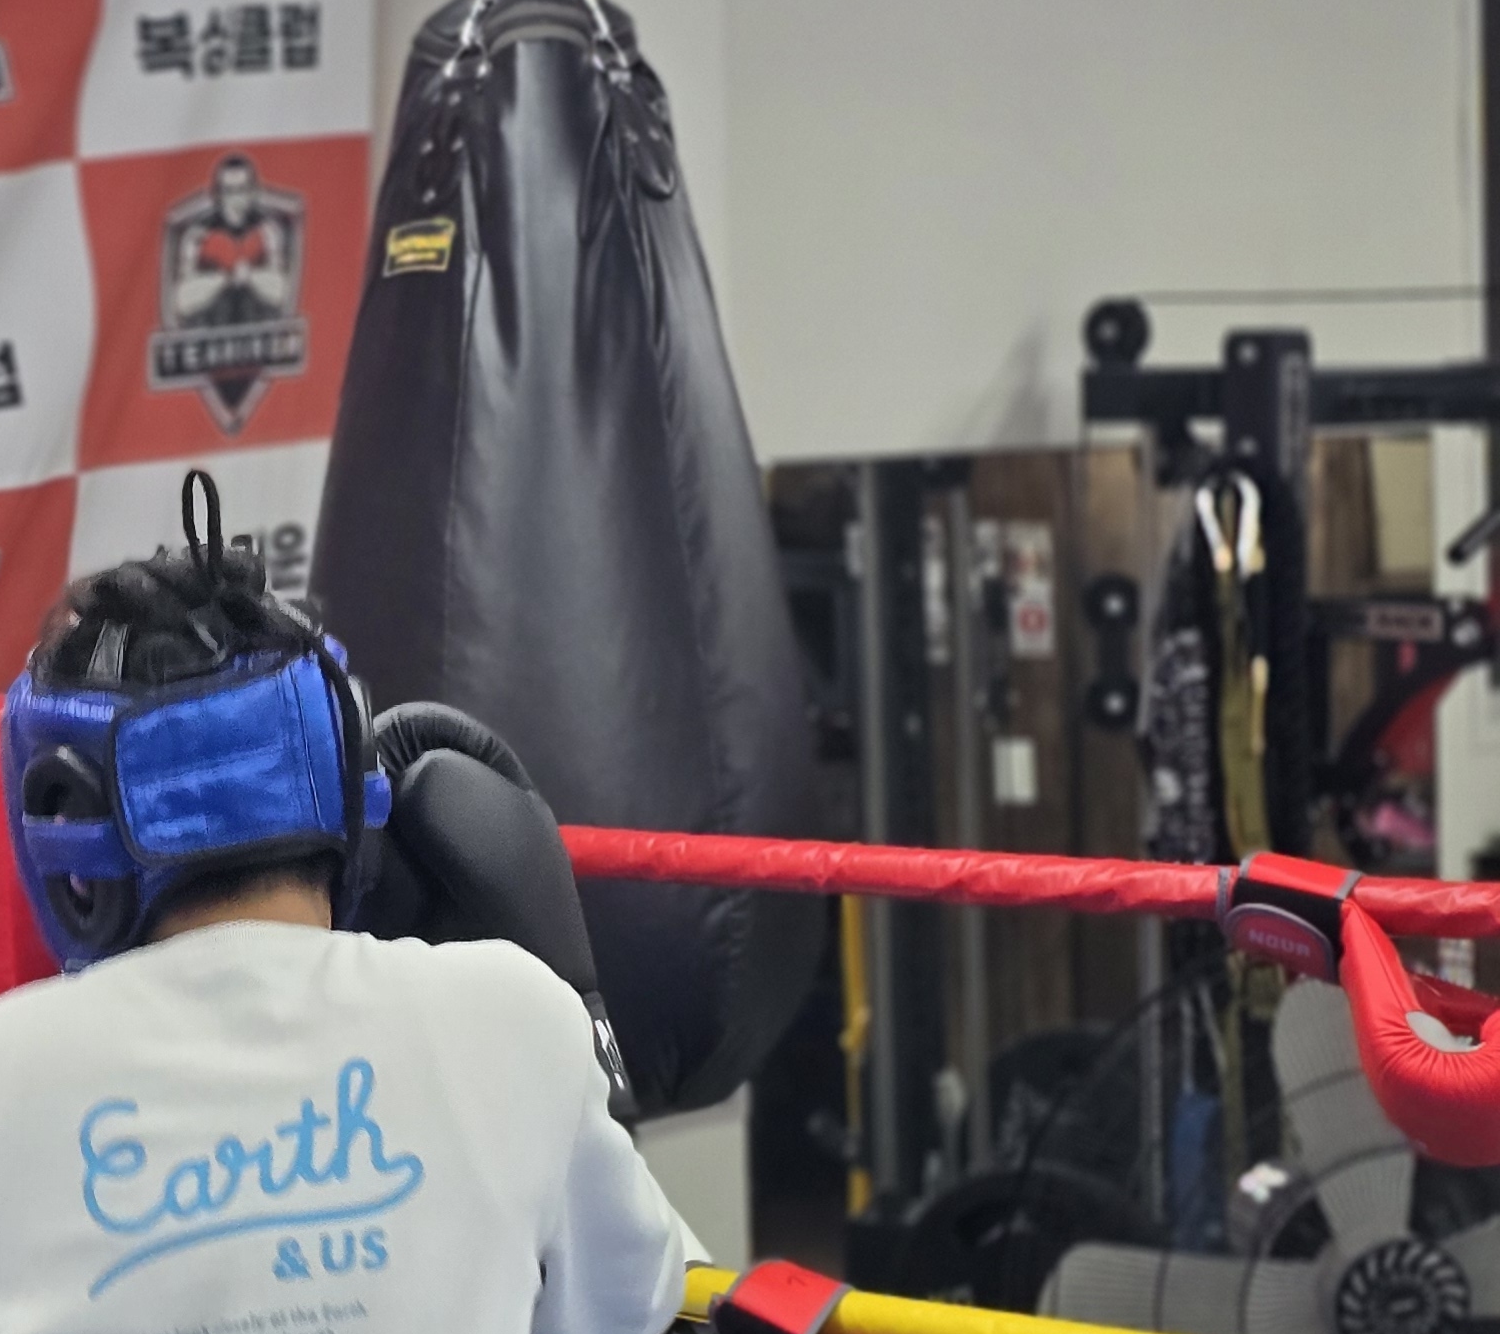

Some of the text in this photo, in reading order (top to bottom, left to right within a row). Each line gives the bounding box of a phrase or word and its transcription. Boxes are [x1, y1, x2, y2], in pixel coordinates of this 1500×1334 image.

[136, 1, 321, 77] 복싱클럽
[80, 1057, 424, 1235] Earth
[319, 1225, 389, 1274] US
